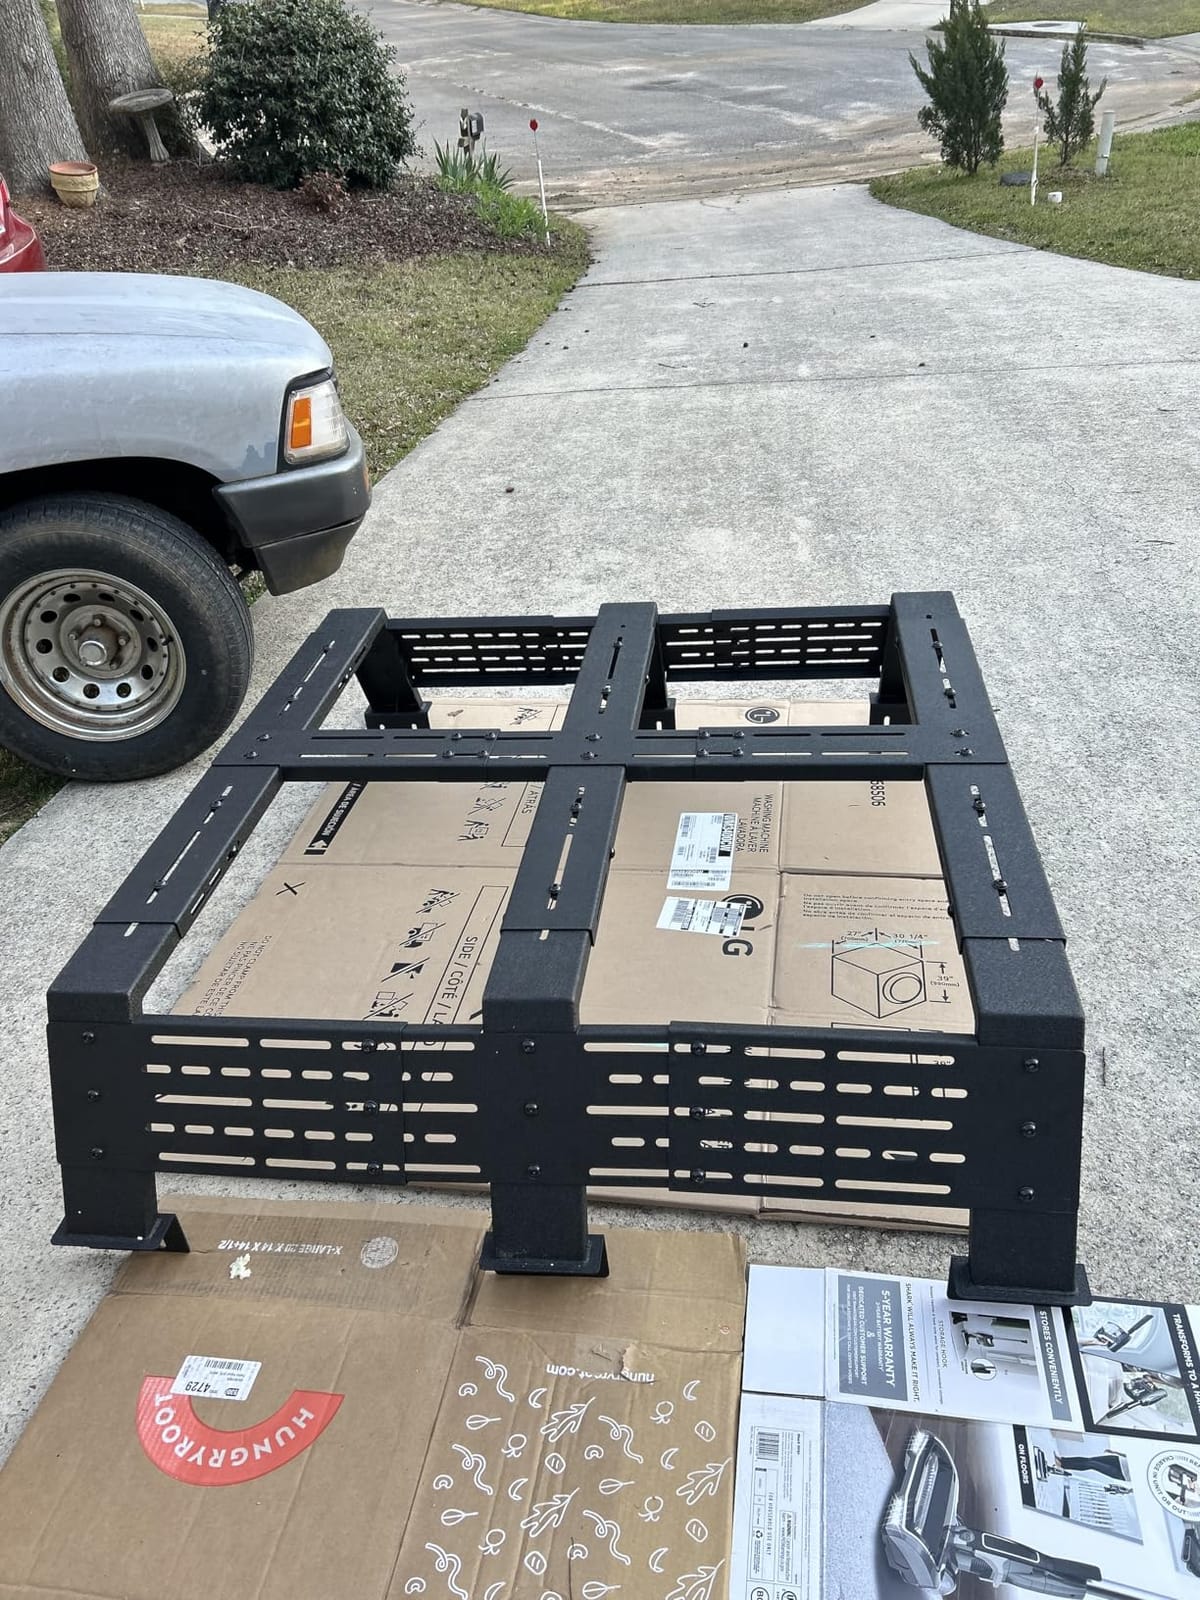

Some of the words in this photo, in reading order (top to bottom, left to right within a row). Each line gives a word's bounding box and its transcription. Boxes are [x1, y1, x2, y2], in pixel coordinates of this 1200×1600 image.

[750, 797, 762, 824] MACHINE
[761, 793, 774, 822] WASHING
[735, 818, 747, 852] LAVADORA
[747, 831, 758, 853] LAVER
[759, 822, 771, 853] MACHINE
[458, 936, 478, 959] SIDE
[441, 970, 464, 999] CÔTÉ
[261, 1242, 274, 1252] 14
[881, 1289, 892, 1325] 5-YEAR
[906, 1305, 914, 1321] WILL
[859, 1320, 867, 1354] CUSTOMER
[866, 1330, 876, 1338] &
[908, 1322, 916, 1350] ALWAYS
[938, 1320, 947, 1347] STORAGE
[1040, 1310, 1052, 1341] STORES
[883, 1326, 896, 1389] WARRANTY
[940, 1348, 948, 1369] HOOK
[1172, 1313, 1194, 1368] TRANSFORMS
[1187, 1369, 1198, 1381] TO
[860, 1355, 868, 1386] SUPPORT
[910, 1351, 918, 1372] MAKE
[1045, 1341, 1063, 1404] CONVENIENTLY
[185, 1381, 211, 1393] 4729
[1018, 1443, 1026, 1459] ON
[1019, 1459, 1030, 1485] FLOORS
[1161, 1496, 1172, 1506] OR
[1171, 1504, 1188, 1515] OUT
